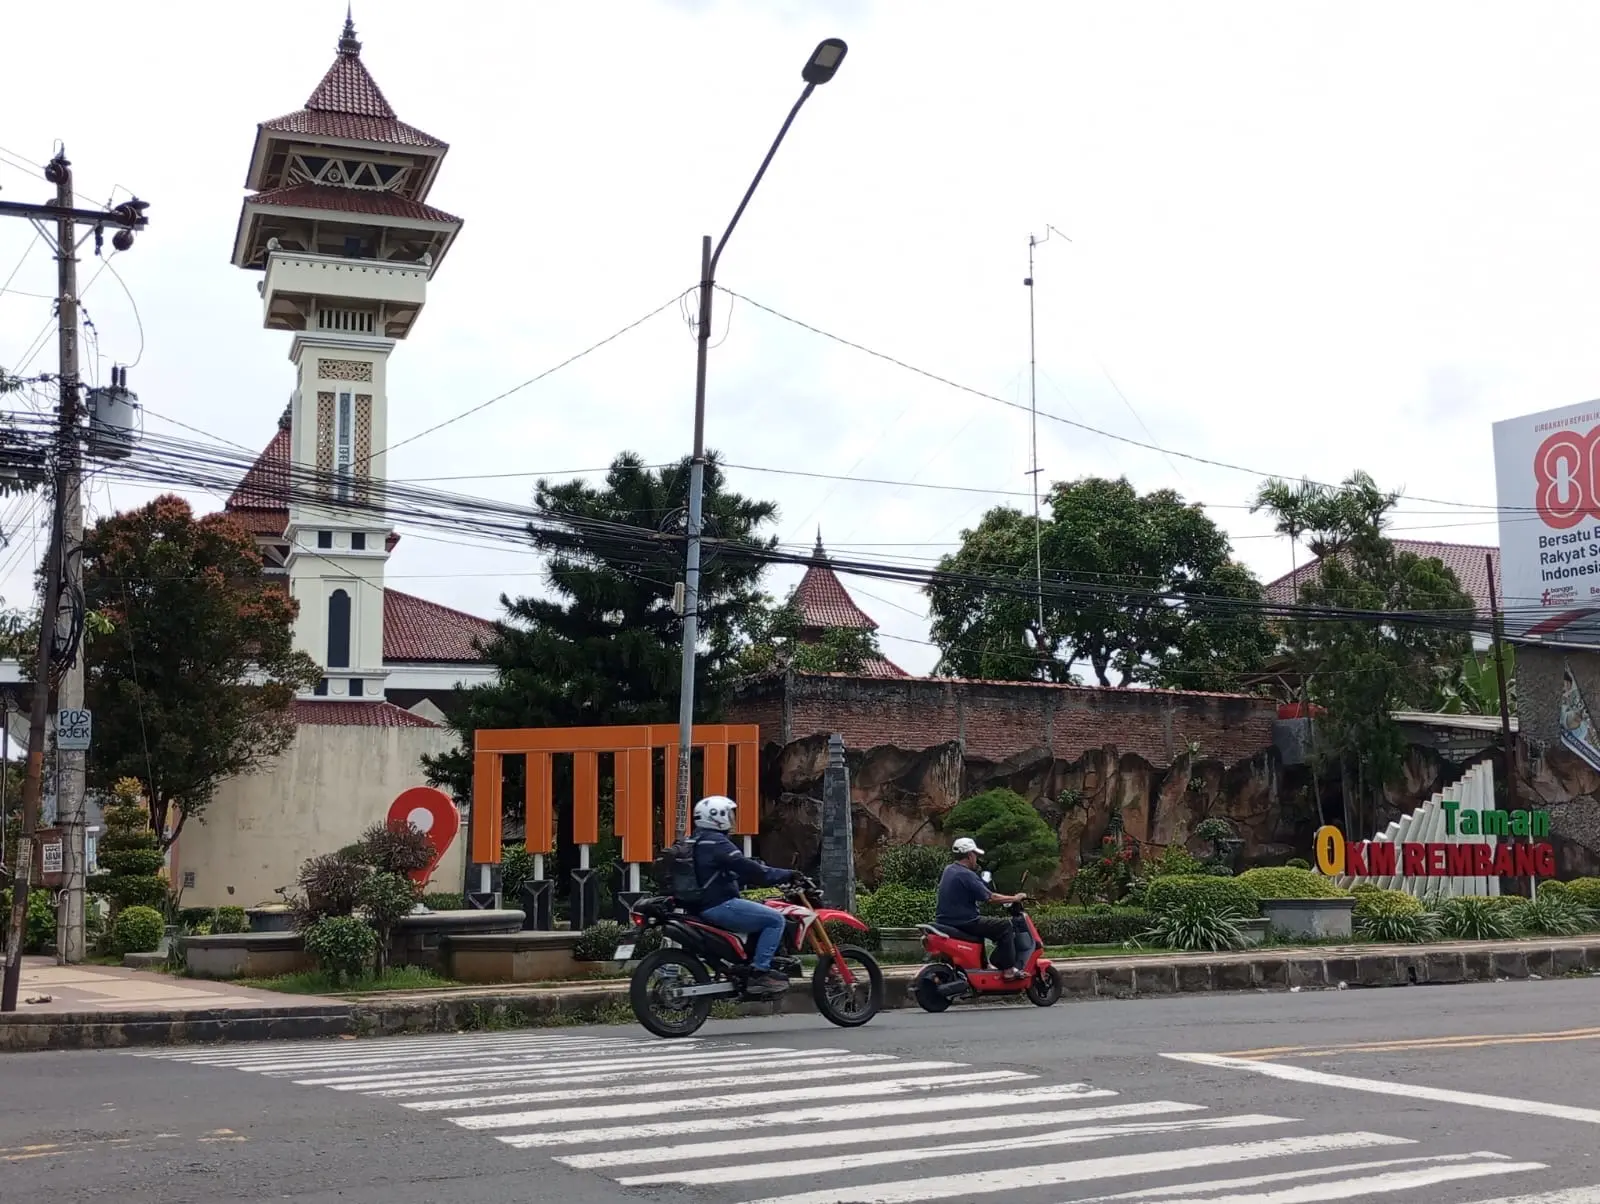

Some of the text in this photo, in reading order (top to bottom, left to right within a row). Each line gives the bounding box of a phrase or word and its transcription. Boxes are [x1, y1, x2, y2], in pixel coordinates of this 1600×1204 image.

[1538, 530, 1591, 549] Bersatu
[1540, 546, 1586, 565] Rakyat
[1541, 560, 1600, 582] Indonesi
[60, 710, 90, 726] POS
[1441, 801, 1551, 837] Taman
[1345, 841, 1397, 877] KM
[1401, 842, 1556, 877] REMBANG
